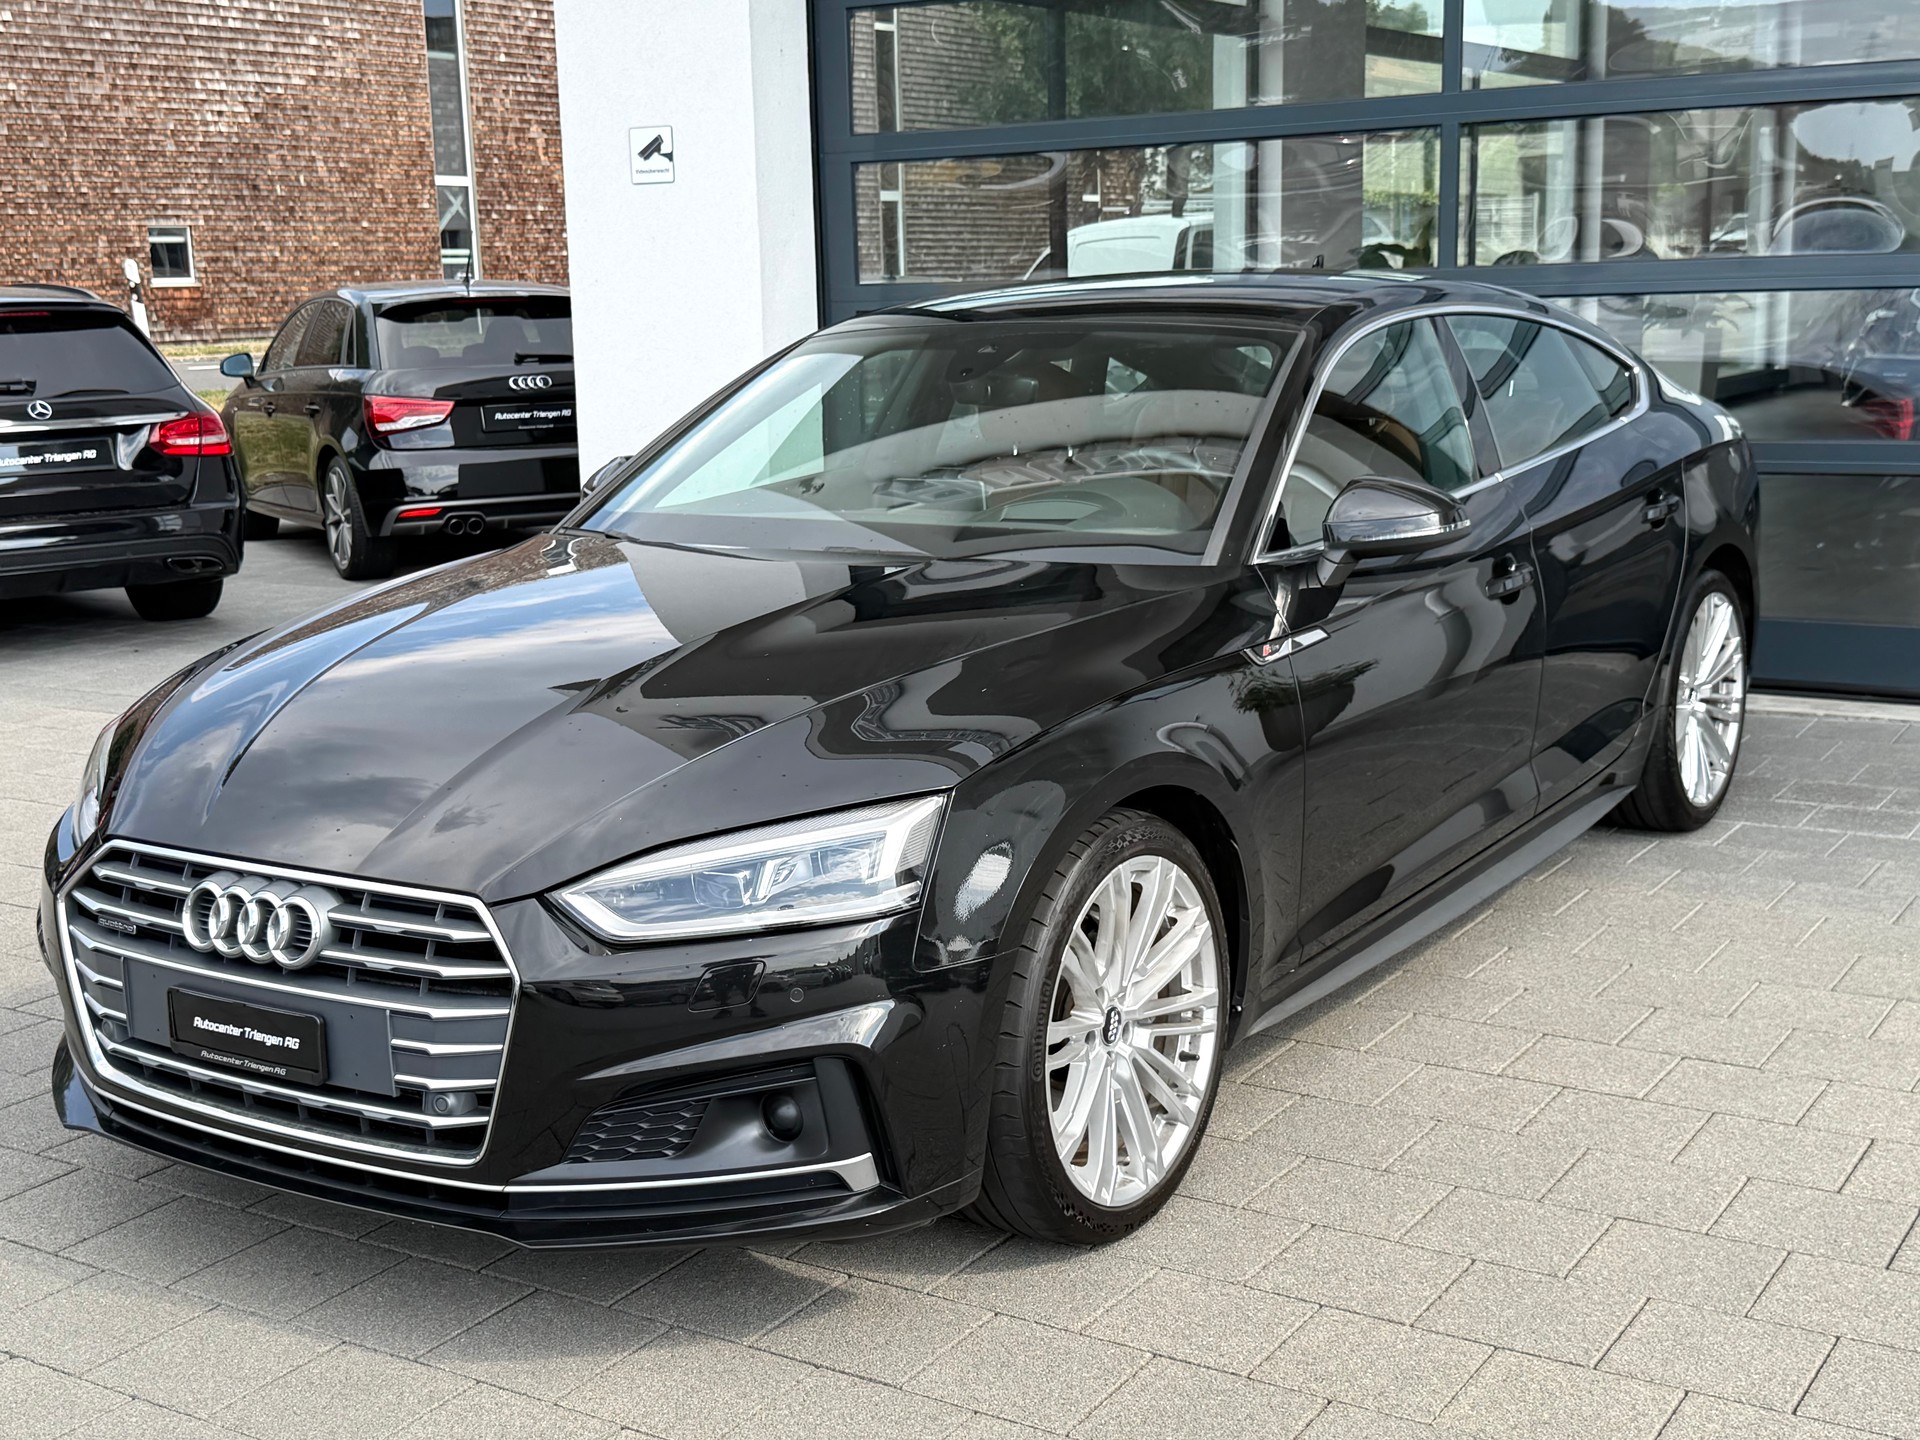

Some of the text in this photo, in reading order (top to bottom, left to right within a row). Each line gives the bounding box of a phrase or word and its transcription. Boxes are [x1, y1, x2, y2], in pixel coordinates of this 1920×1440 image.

[495, 408, 572, 420] Autocenter Triengen AG
[0, 449, 97, 467] utocenter Triengen AG
[99, 918, 134, 932] quattro
[193, 1016, 300, 1049] Autocenter Triengen AG
[200, 1050, 287, 1076] Autocenter Triengen AG
